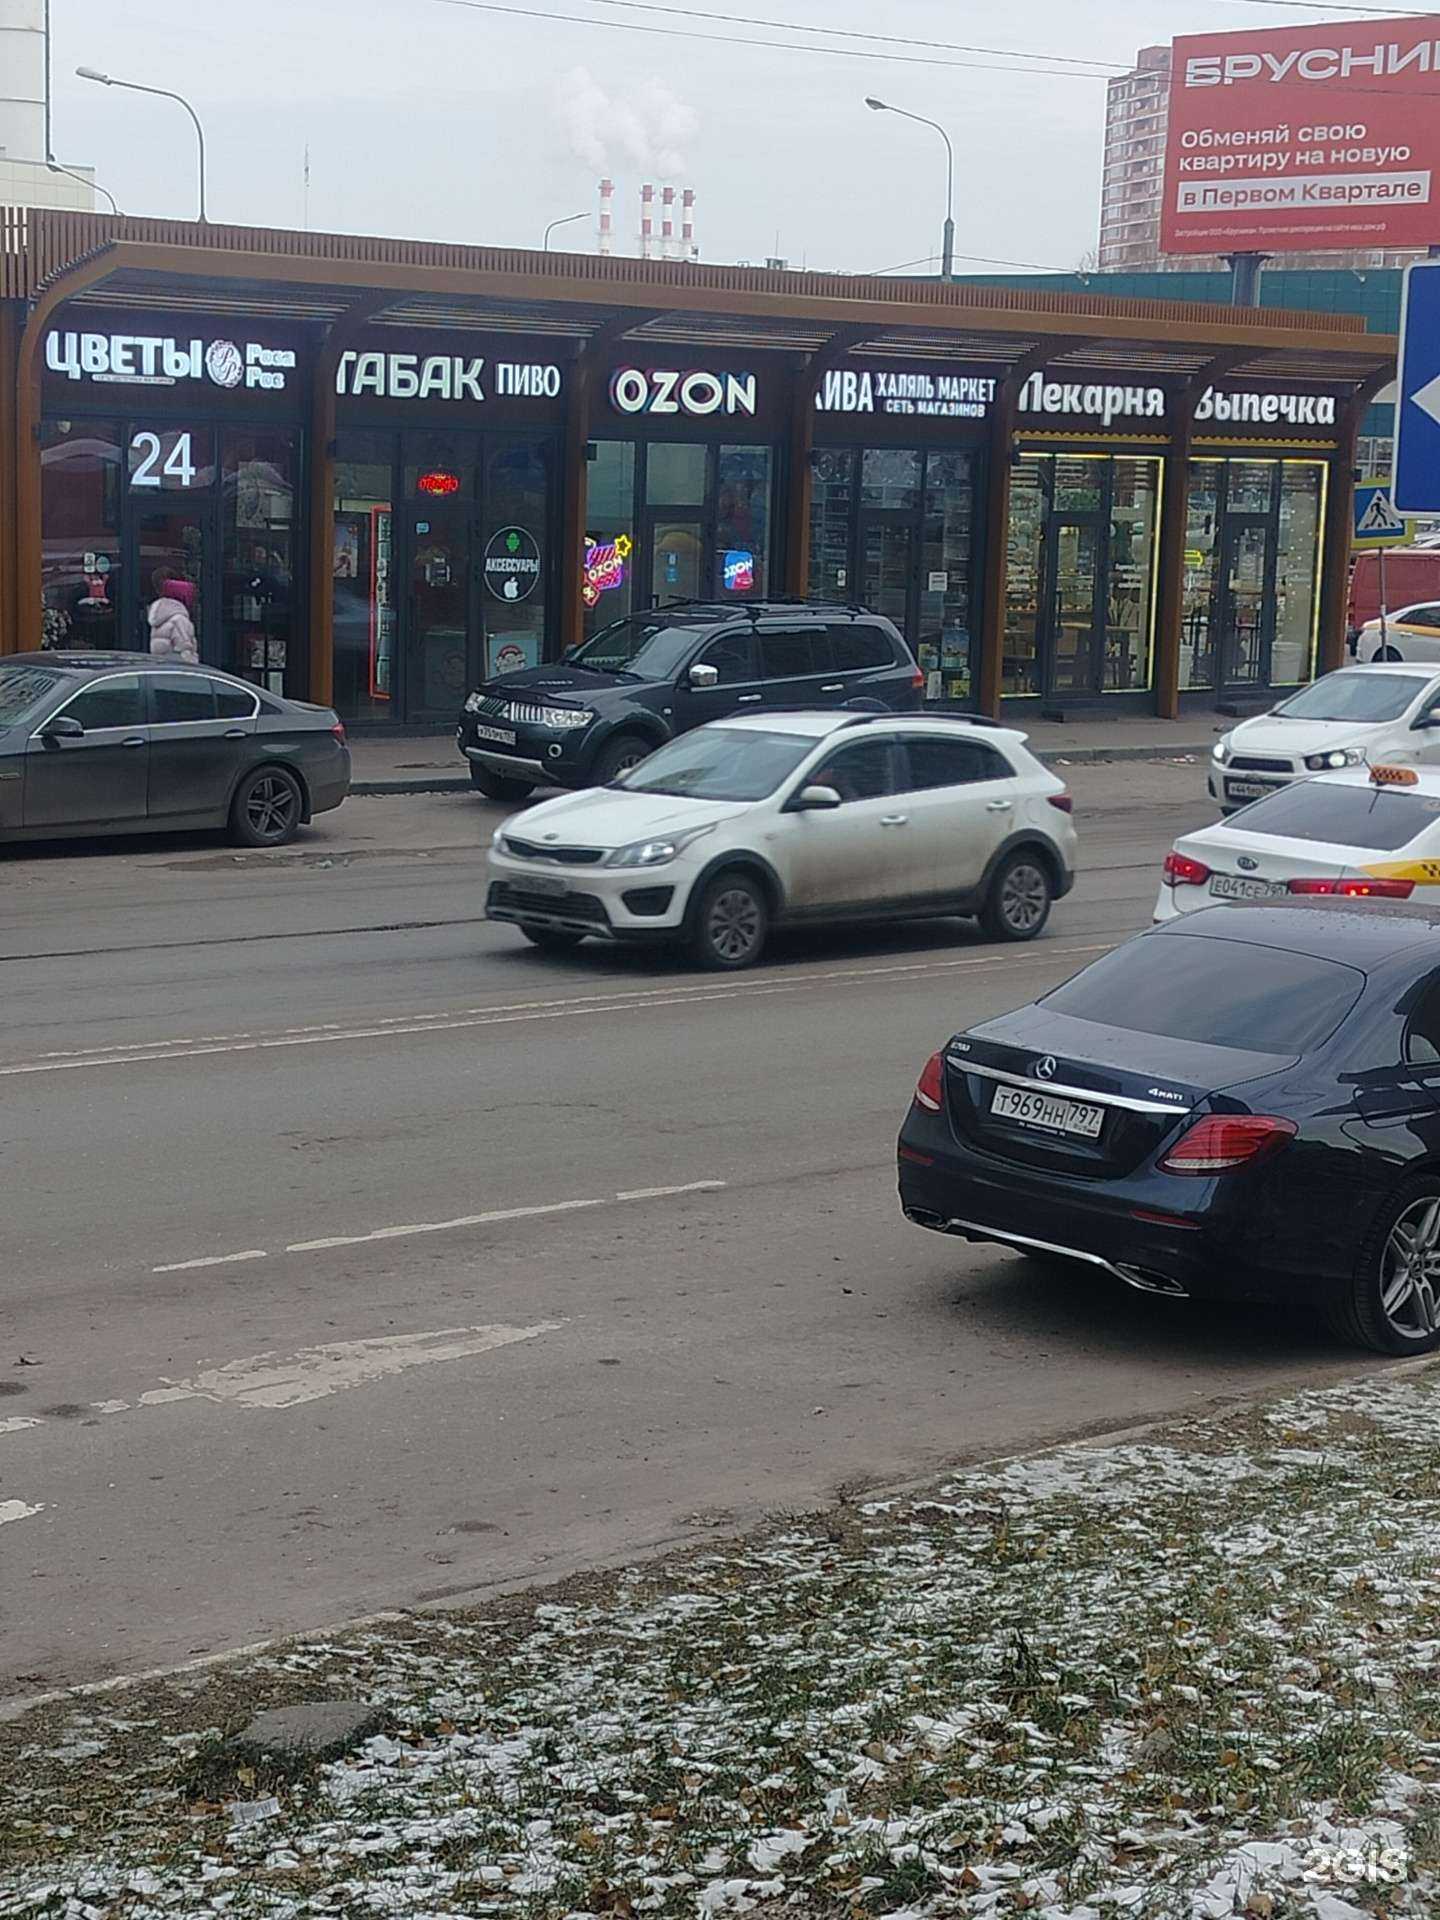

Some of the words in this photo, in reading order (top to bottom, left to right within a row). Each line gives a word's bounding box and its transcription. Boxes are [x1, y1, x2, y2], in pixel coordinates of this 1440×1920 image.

[1185, 41, 1440, 88] БРУСНИ
[1181, 124, 1290, 149] Обменяй
[1298, 124, 1367, 142] свою
[1179, 150, 1290, 173] квартиру
[1295, 151, 1324, 166] на
[1330, 145, 1411, 167] новую
[1184, 192, 1196, 206] в
[1202, 185, 1295, 207] Первом
[1302, 181, 1421, 205] Квартале
[45, 331, 202, 379] ЦВЕТЫ
[497, 363, 560, 397] ПИВО
[614, 369, 757, 416] OZON
[815, 370, 873, 412] ИВА
[876, 373, 934, 398] ХАЛЯЛЬ
[938, 377, 996, 402] МАРКЕТ
[885, 400, 914, 414] СЕТЬ
[917, 401, 986, 418] МАГАЗИНОВ
[1018, 372, 1164, 426] Пекарня
[130, 432, 197, 487] 24
[485, 557, 539, 573] АКСЕССУАРЫ
[588, 556, 623, 580] OZON
